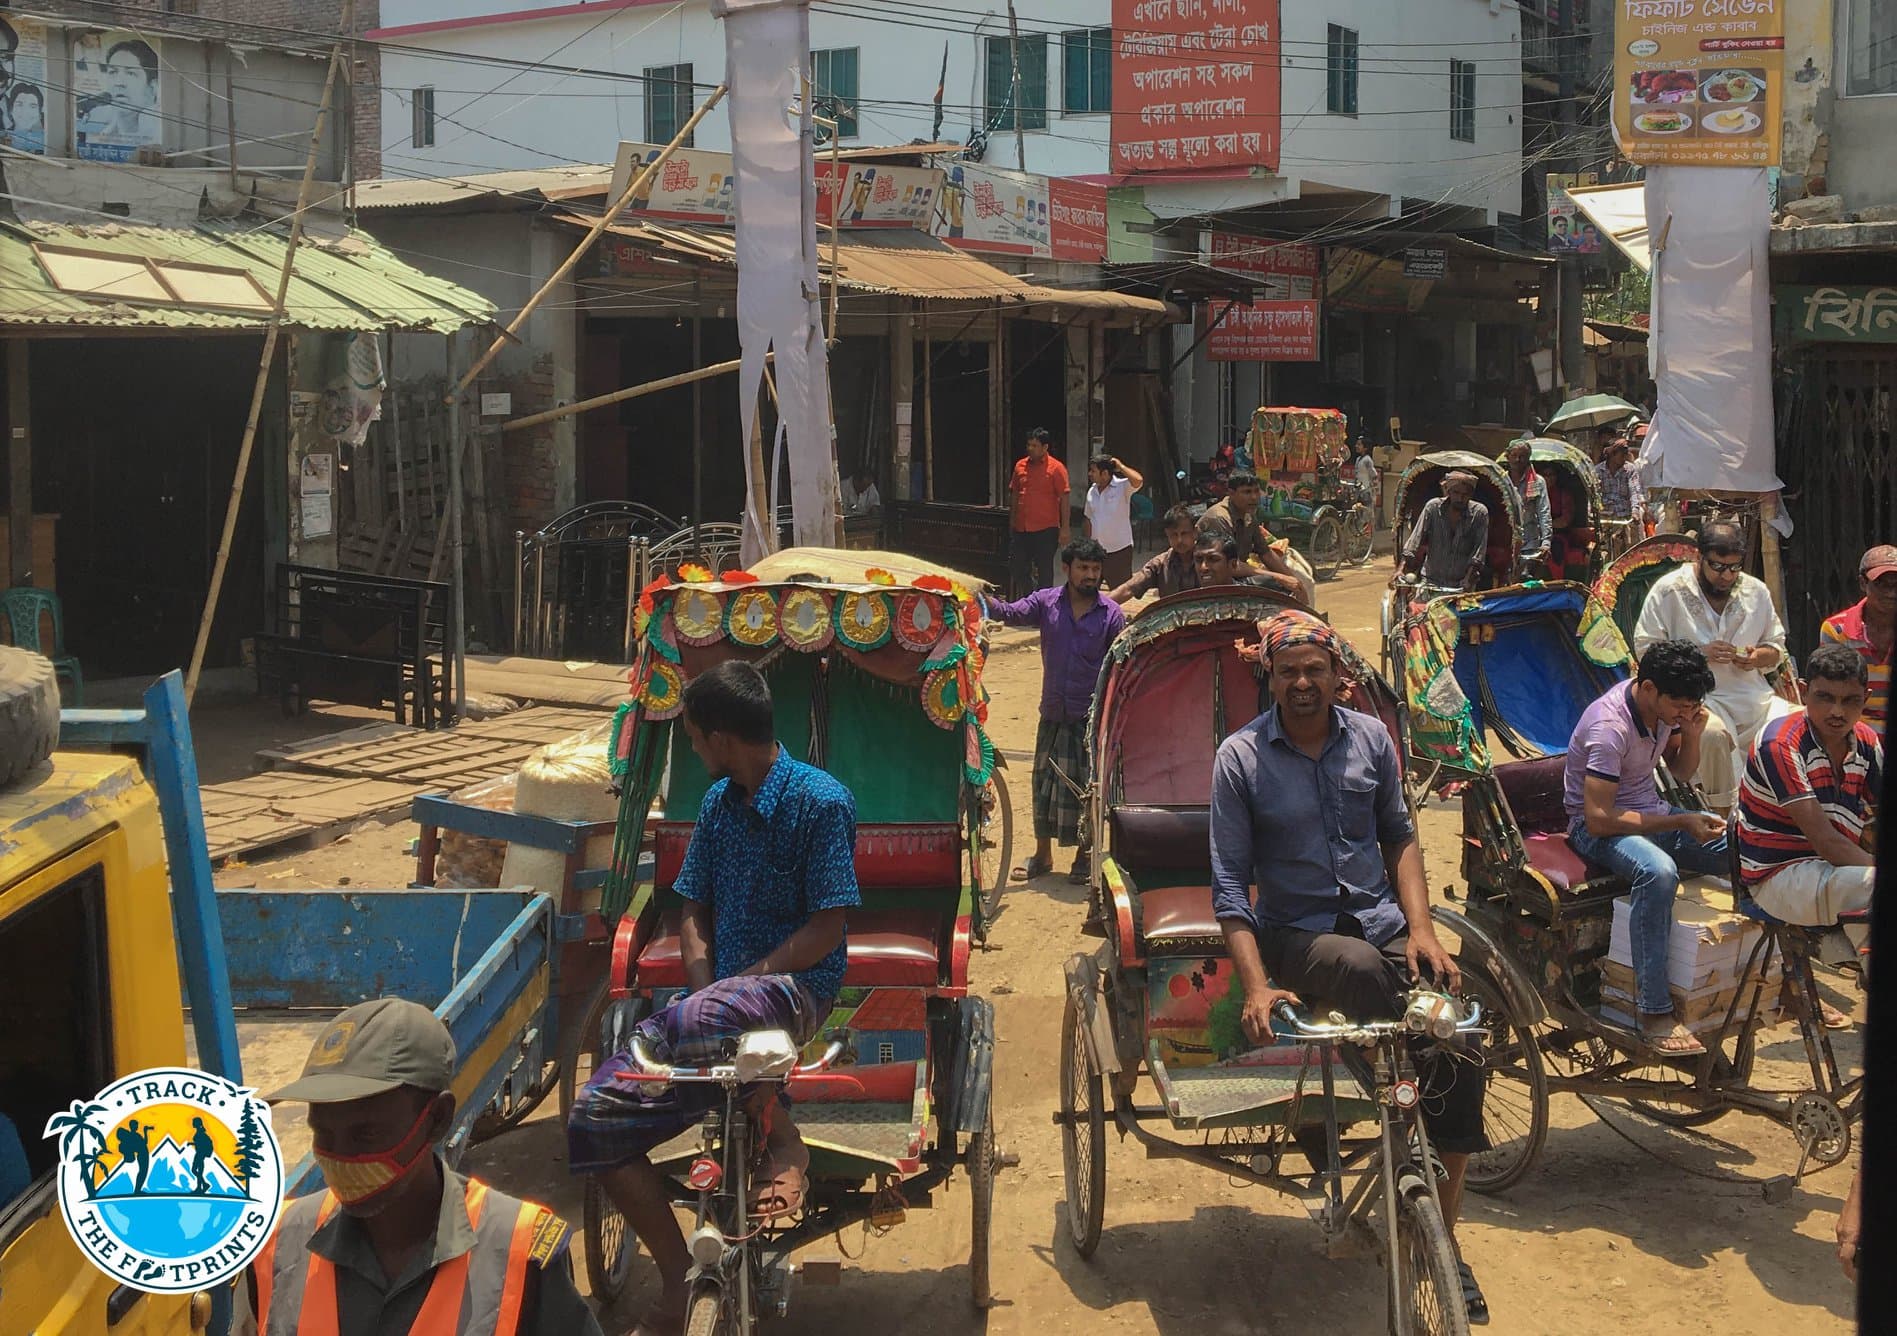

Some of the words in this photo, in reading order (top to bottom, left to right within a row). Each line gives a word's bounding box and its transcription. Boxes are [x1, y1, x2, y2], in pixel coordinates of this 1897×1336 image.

[1133, 65, 1191, 91] অপারেশন
[1195, 64, 1217, 88] সহ
[1220, 61, 1254, 83] সকল
[1181, 96, 1246, 122] অপারেশন
[1213, 131, 1239, 154] করা
